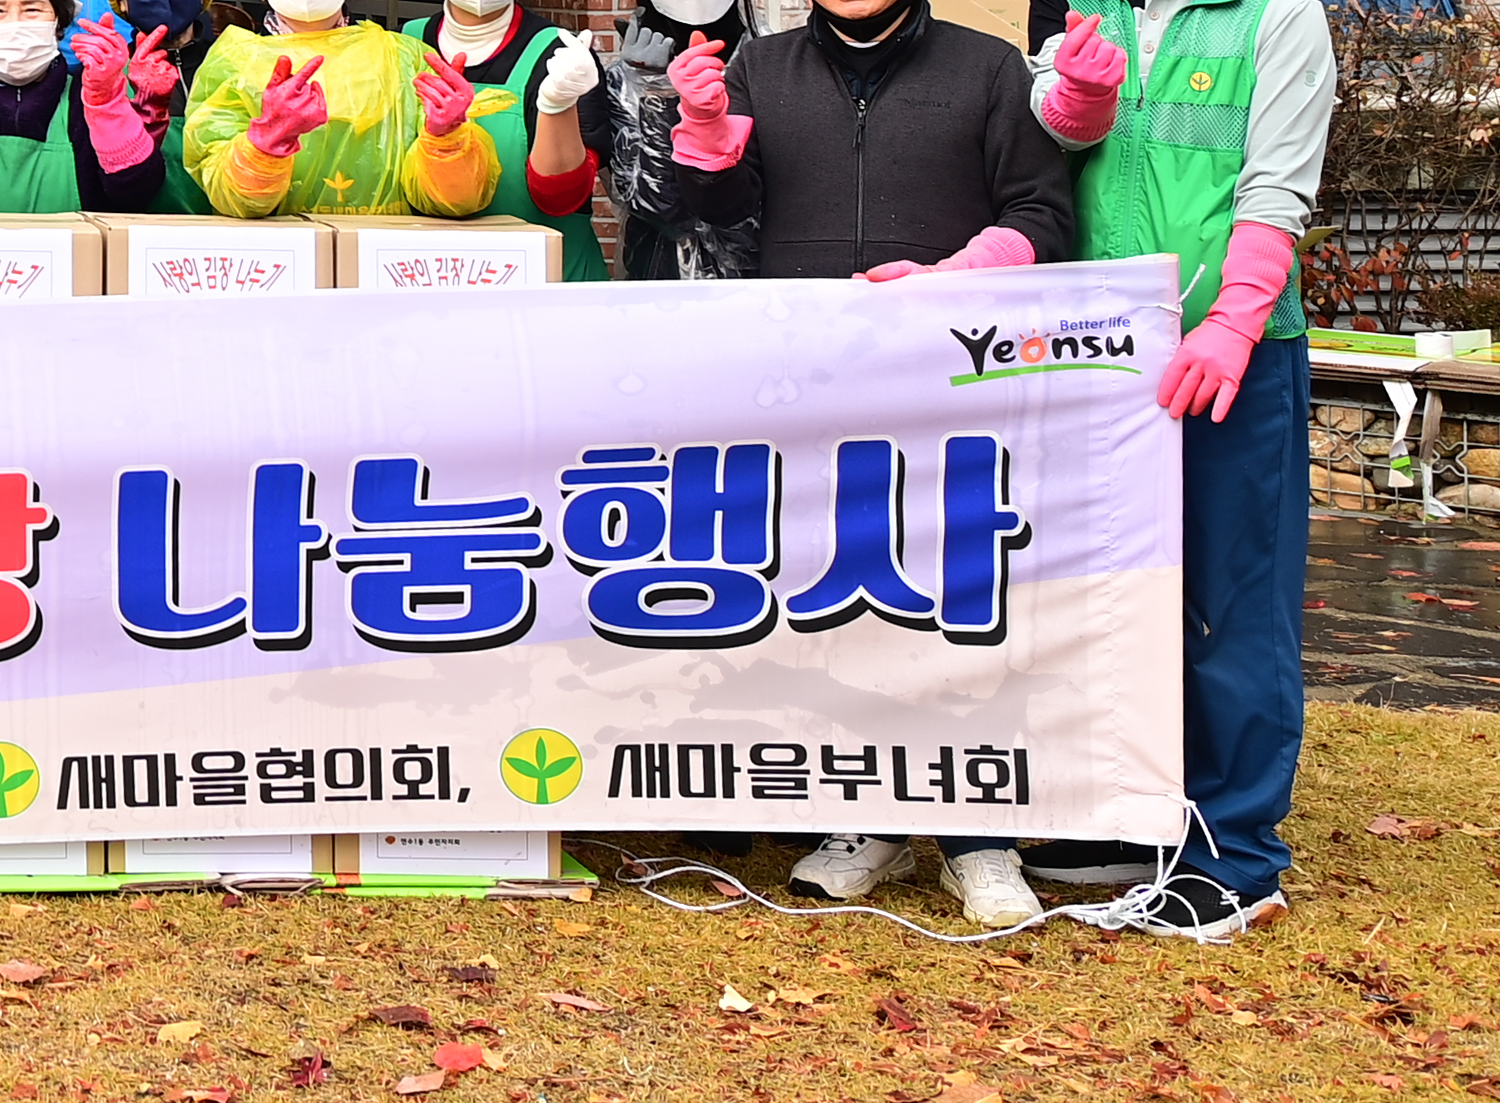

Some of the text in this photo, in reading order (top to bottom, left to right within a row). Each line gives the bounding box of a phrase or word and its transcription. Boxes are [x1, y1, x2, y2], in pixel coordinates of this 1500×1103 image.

[152, 256, 287, 293] 사랑의 김장 나누기
[1059, 316, 1131, 332] Better life
[949, 325, 1134, 377] Yeonsu
[56, 743, 471, 812] 새마을협의회,
[606, 742, 1031, 806] 새마을부녀회
